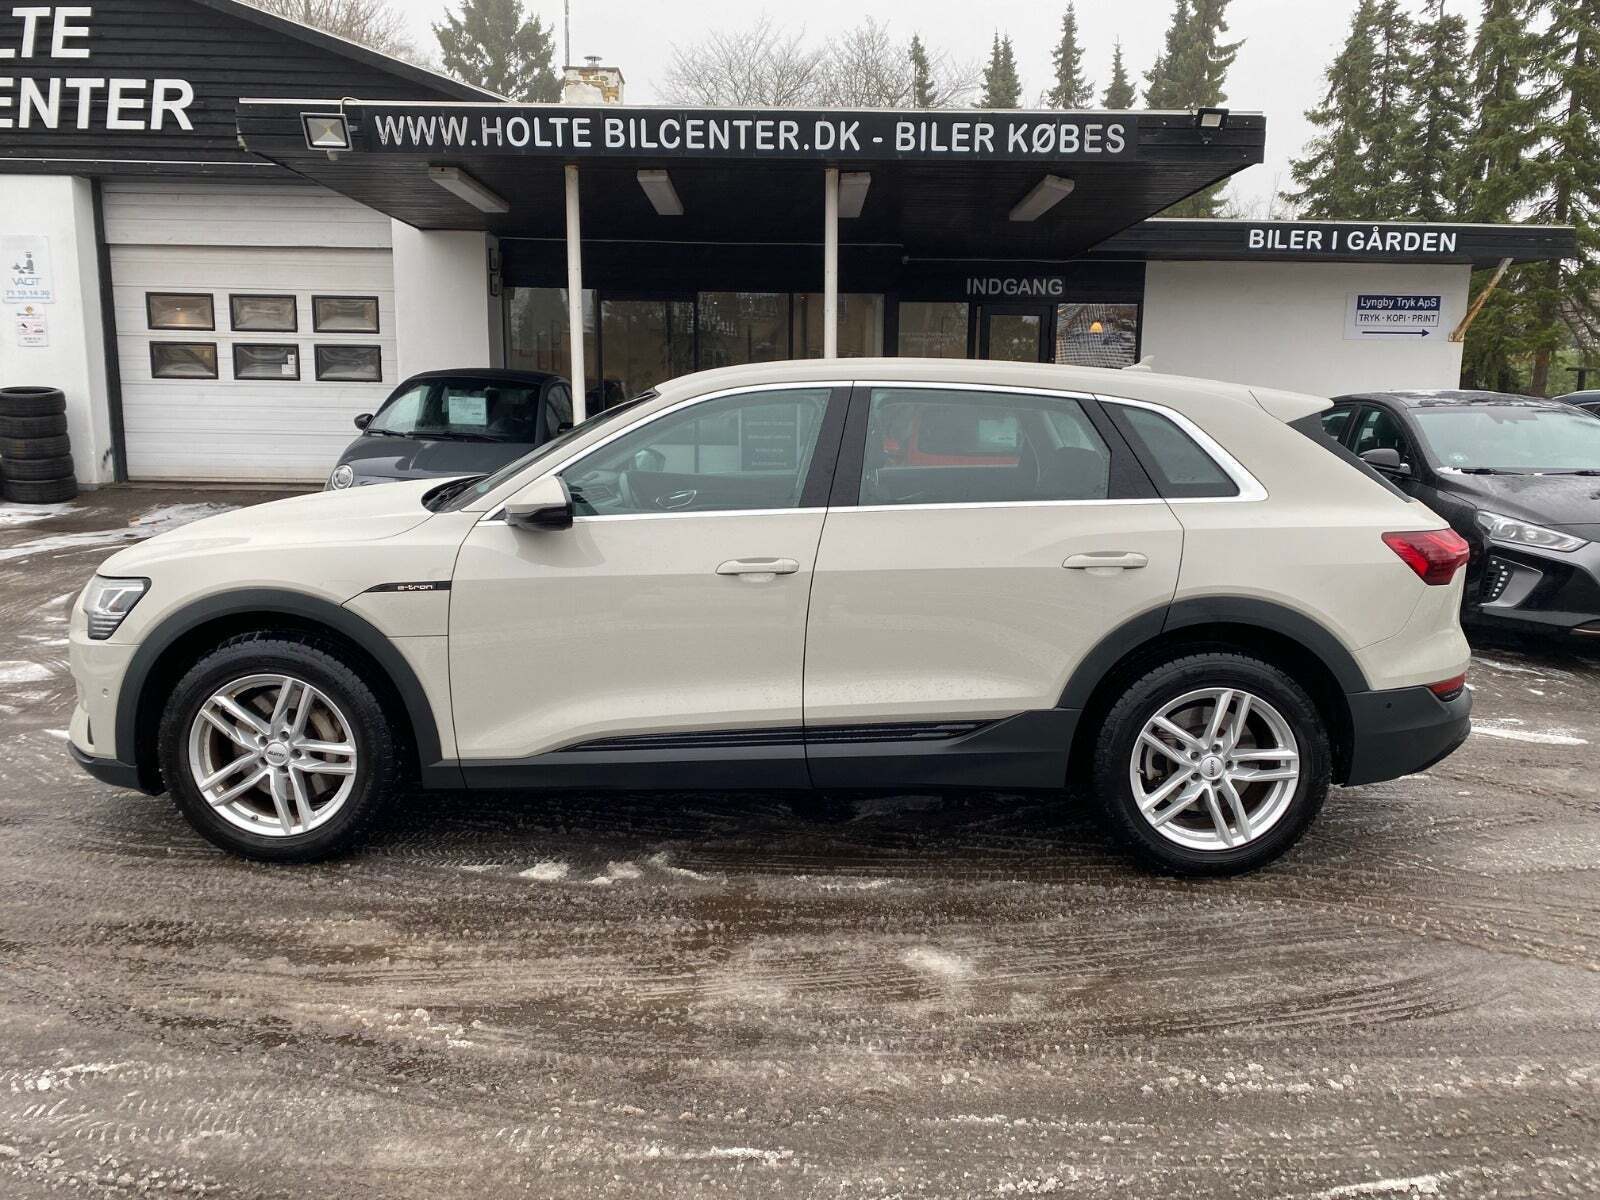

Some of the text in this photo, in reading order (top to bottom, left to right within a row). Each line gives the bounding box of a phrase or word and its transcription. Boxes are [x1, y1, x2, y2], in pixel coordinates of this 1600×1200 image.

[374, 115, 592, 148] WWW.HOLTE
[604, 118, 861, 152] BILCENTER.DK
[895, 121, 994, 153] BILER
[1007, 123, 1126, 153] KØBES
[1249, 226, 1457, 252] BILER I GÅRDEN
[966, 278, 1063, 295] INDGANG
[1360, 297, 1437, 309] Lyngby Tryk ApS
[1359, 314, 1436, 323] TRYK KOPI PRINT
